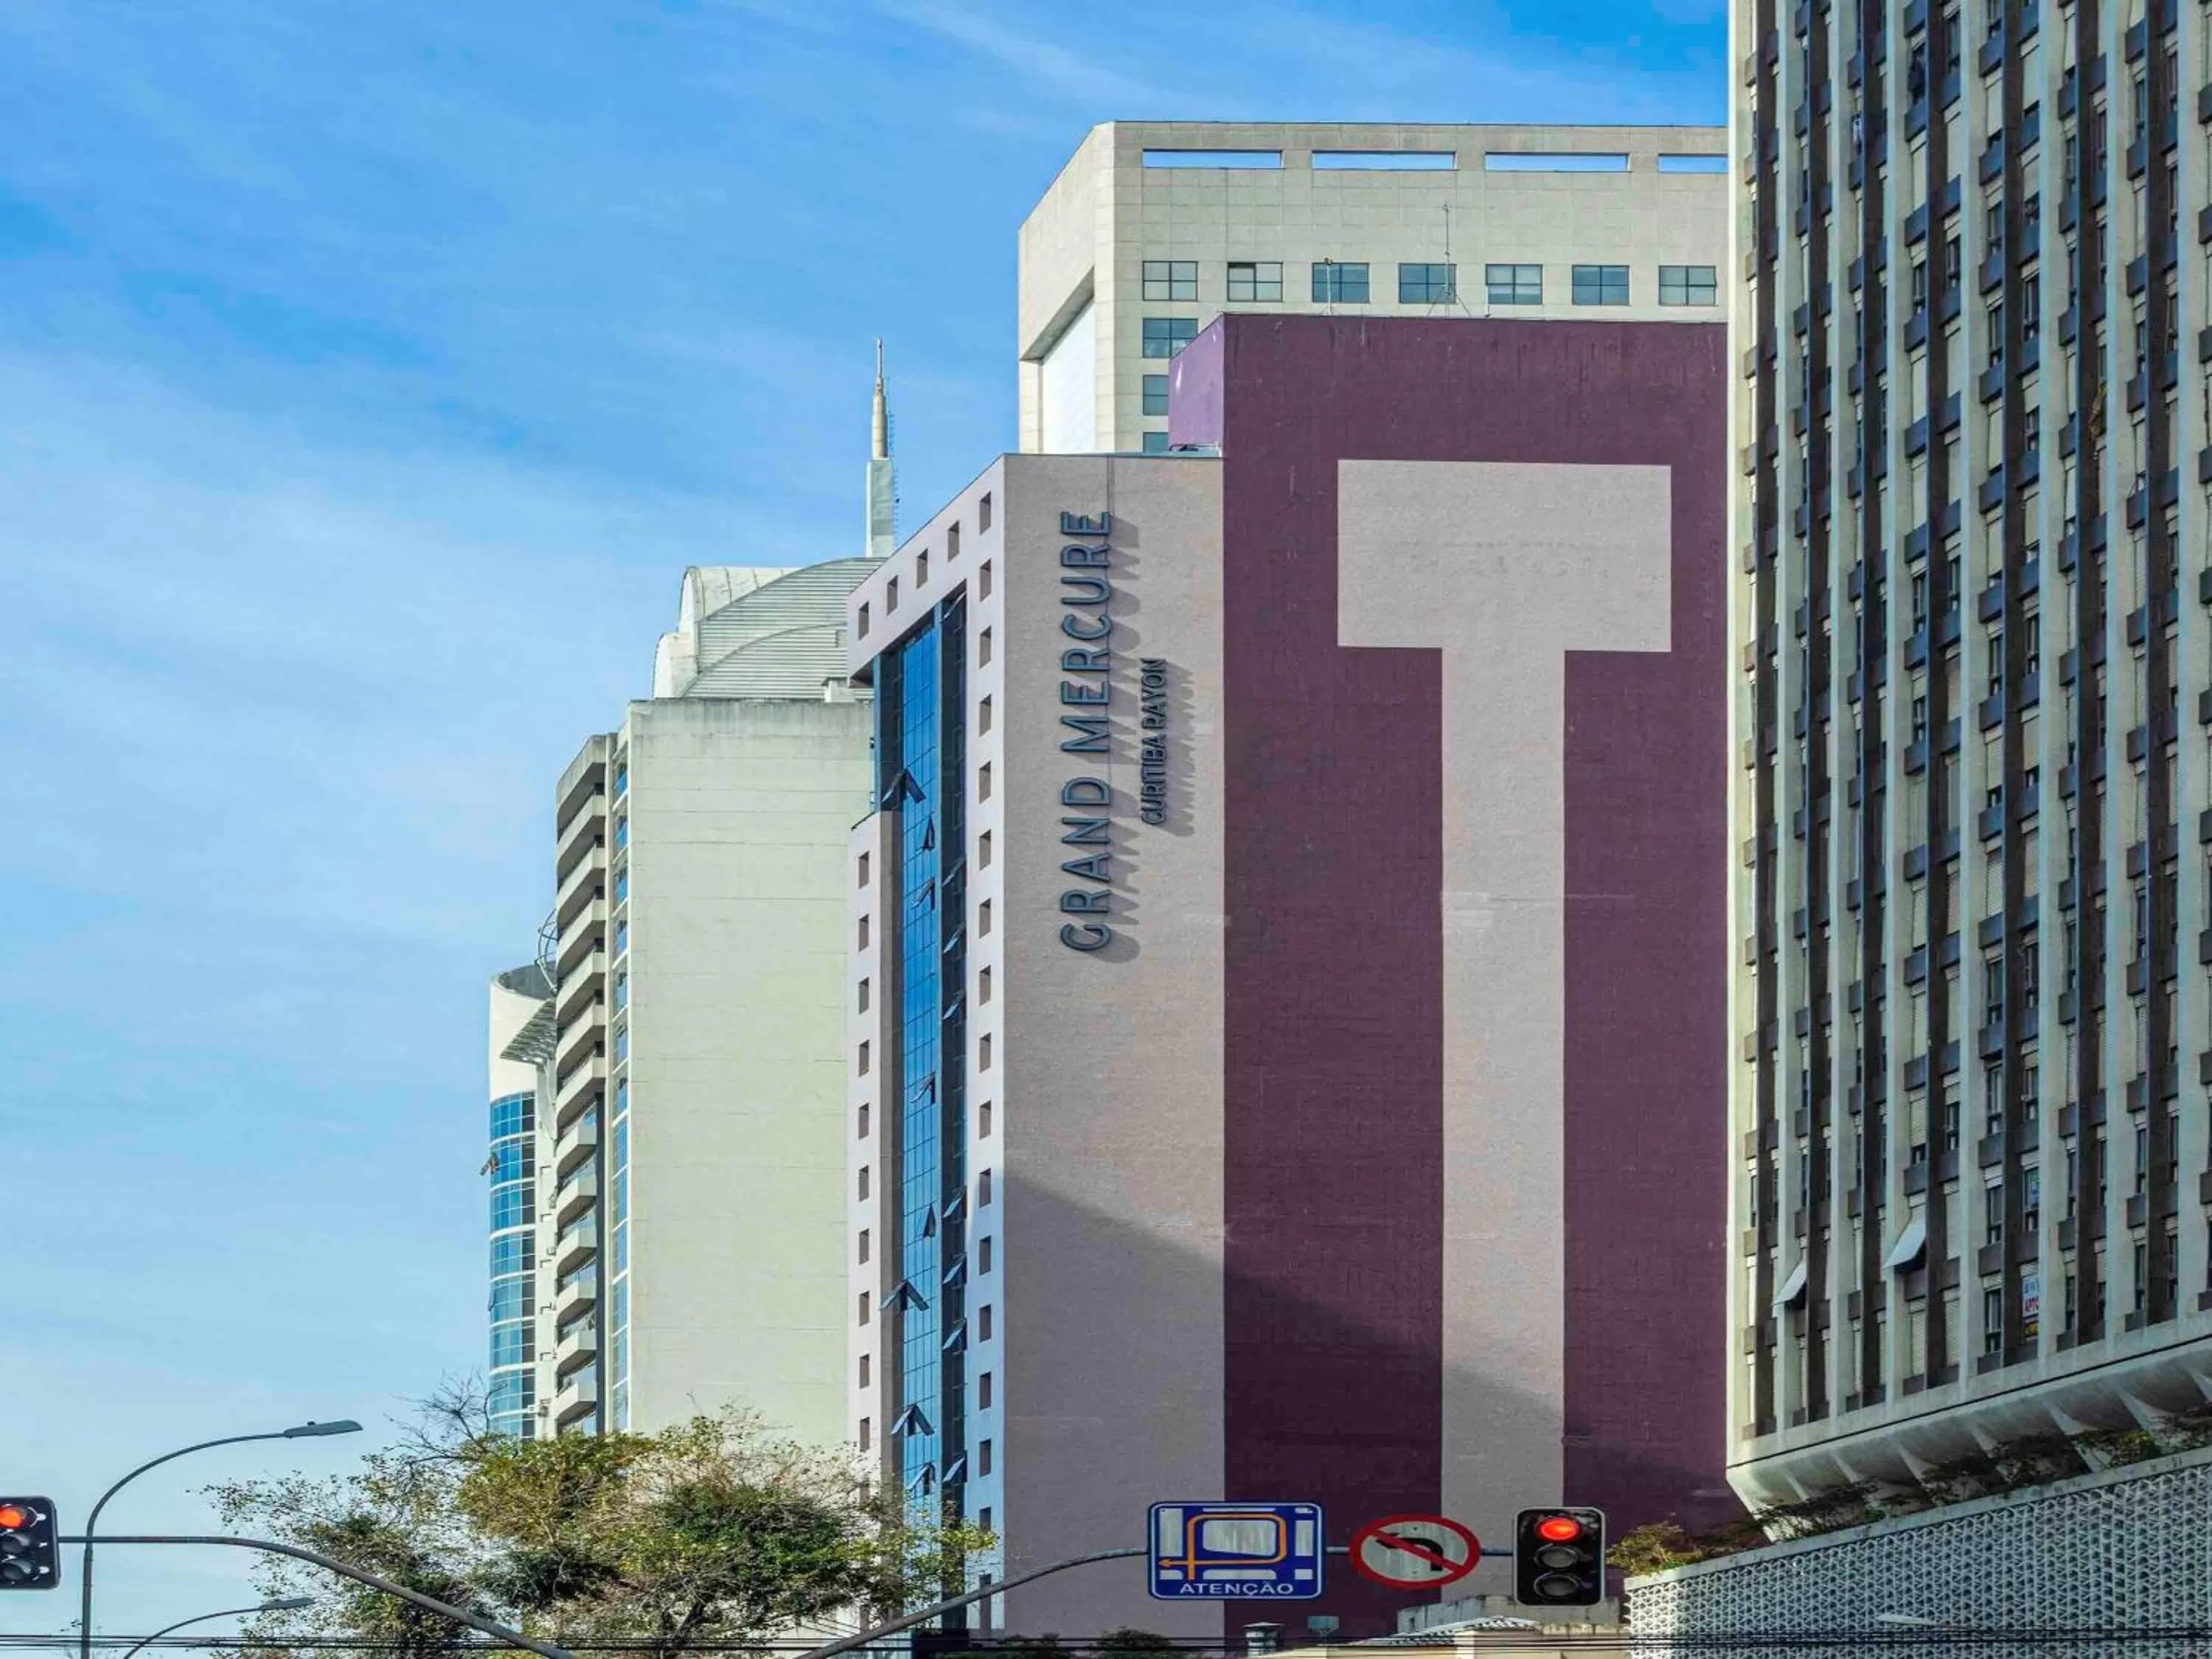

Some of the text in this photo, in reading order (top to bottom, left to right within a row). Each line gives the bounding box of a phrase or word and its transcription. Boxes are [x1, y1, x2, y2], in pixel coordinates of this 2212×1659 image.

[1061, 511, 1111, 951] GRAND MERCURE
[1141, 658, 1167, 825] CURITIBA RAYON
[1180, 1581, 1293, 1596] ATENÇÃO
